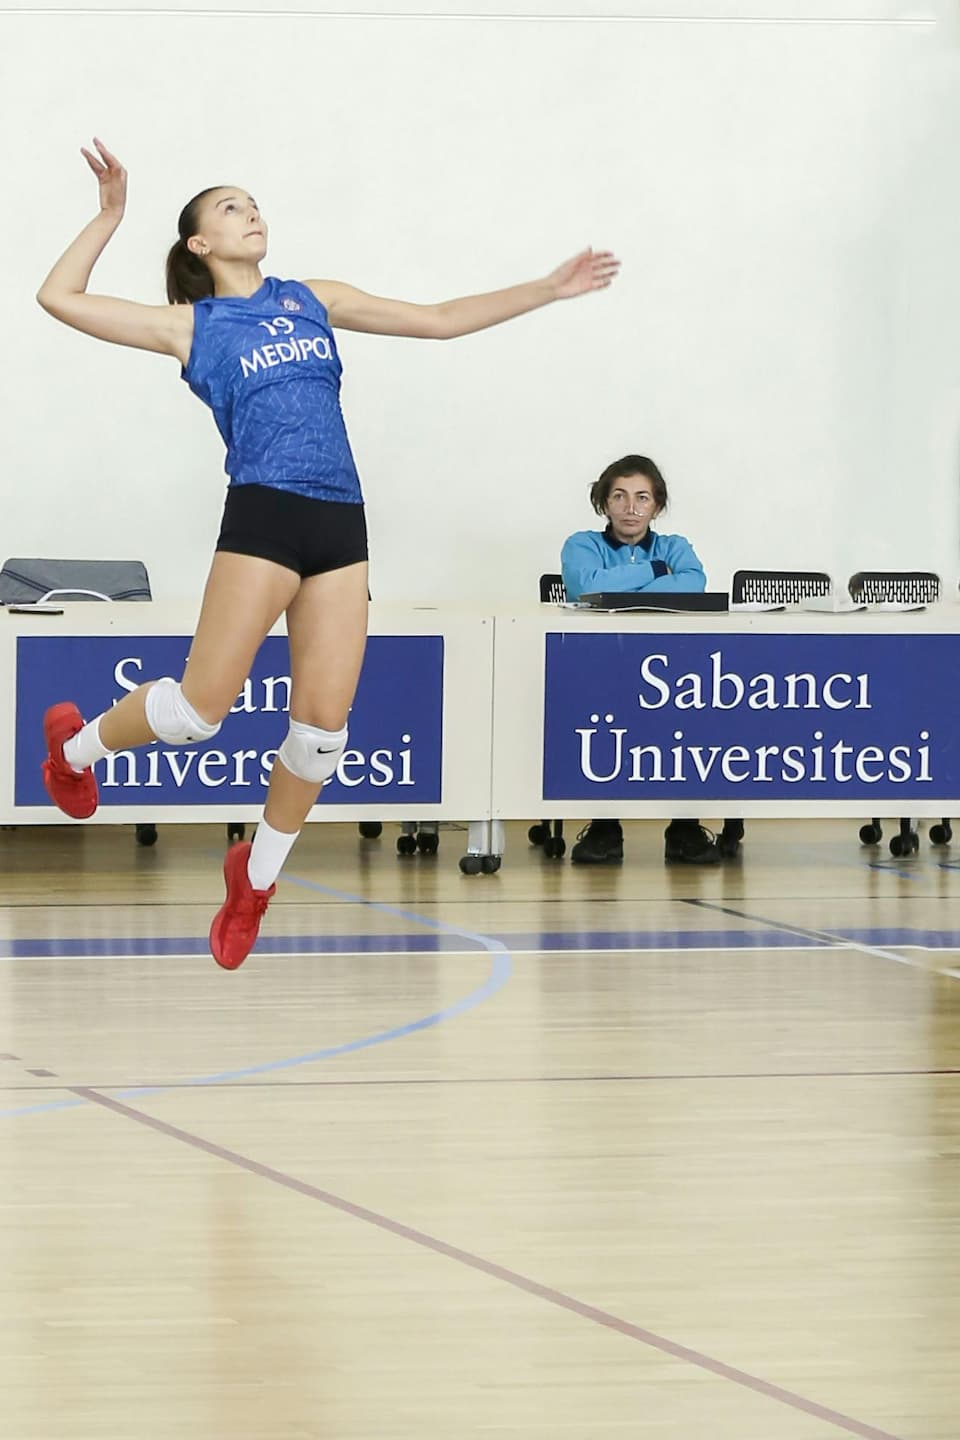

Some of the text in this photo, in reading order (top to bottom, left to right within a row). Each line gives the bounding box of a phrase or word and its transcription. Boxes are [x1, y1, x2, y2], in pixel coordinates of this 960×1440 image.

[257, 316, 295, 337] 19
[638, 651, 873, 710] Sabancı
[92, 733, 416, 788] niversesi
[575, 713, 934, 783] Üniversitesi
